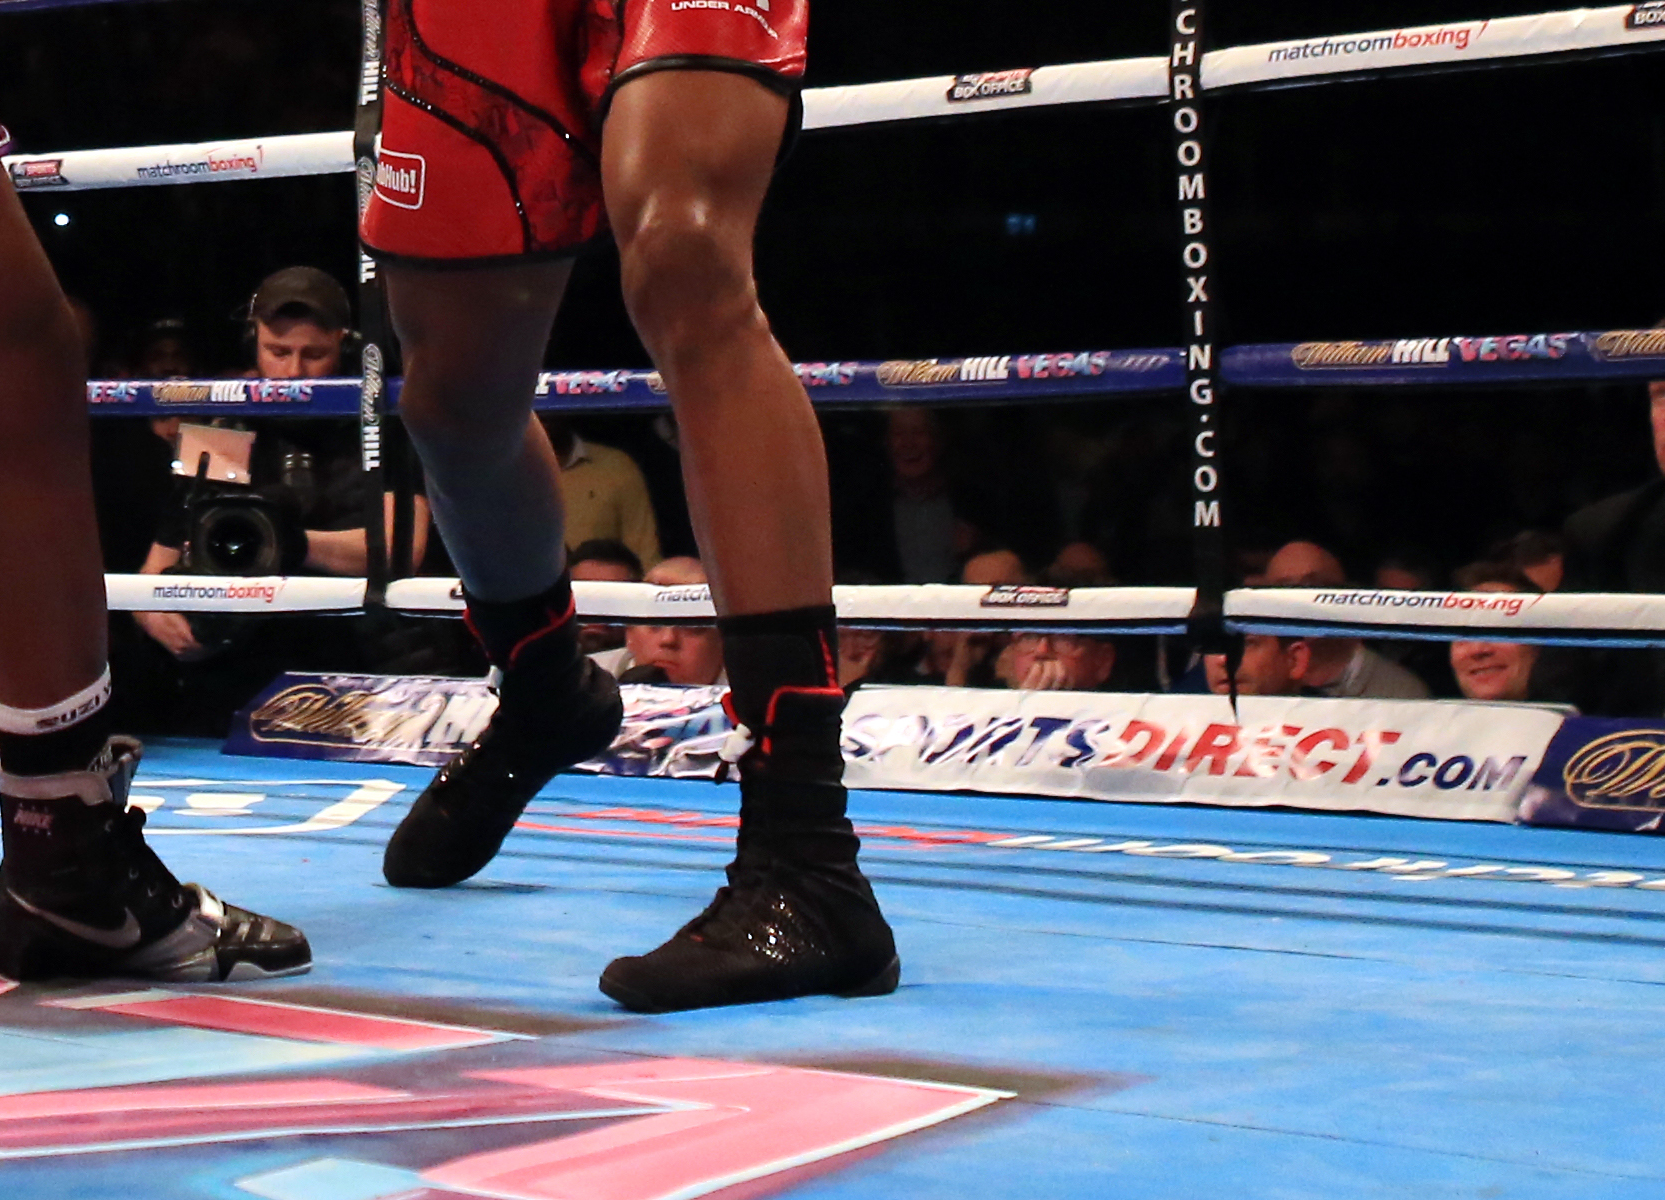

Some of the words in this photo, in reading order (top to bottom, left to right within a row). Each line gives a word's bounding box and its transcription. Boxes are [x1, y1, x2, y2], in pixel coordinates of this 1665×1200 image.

[670, 0, 731, 11] UNDER
[1268, 26, 1472, 63] matchroomboxing
[361, 61, 380, 106] HILL
[1391, 337, 1451, 365] HILL
[1454, 333, 1571, 363] VEGAS
[959, 355, 1011, 382] HILL
[1017, 350, 1111, 379] VEGAS
[87, 381, 138, 403] EGAS
[210, 379, 248, 403] HILL
[362, 426, 381, 473] HILL
[153, 582, 275, 603] matchroomboxing
[1312, 590, 1525, 616] matchroomboxing
